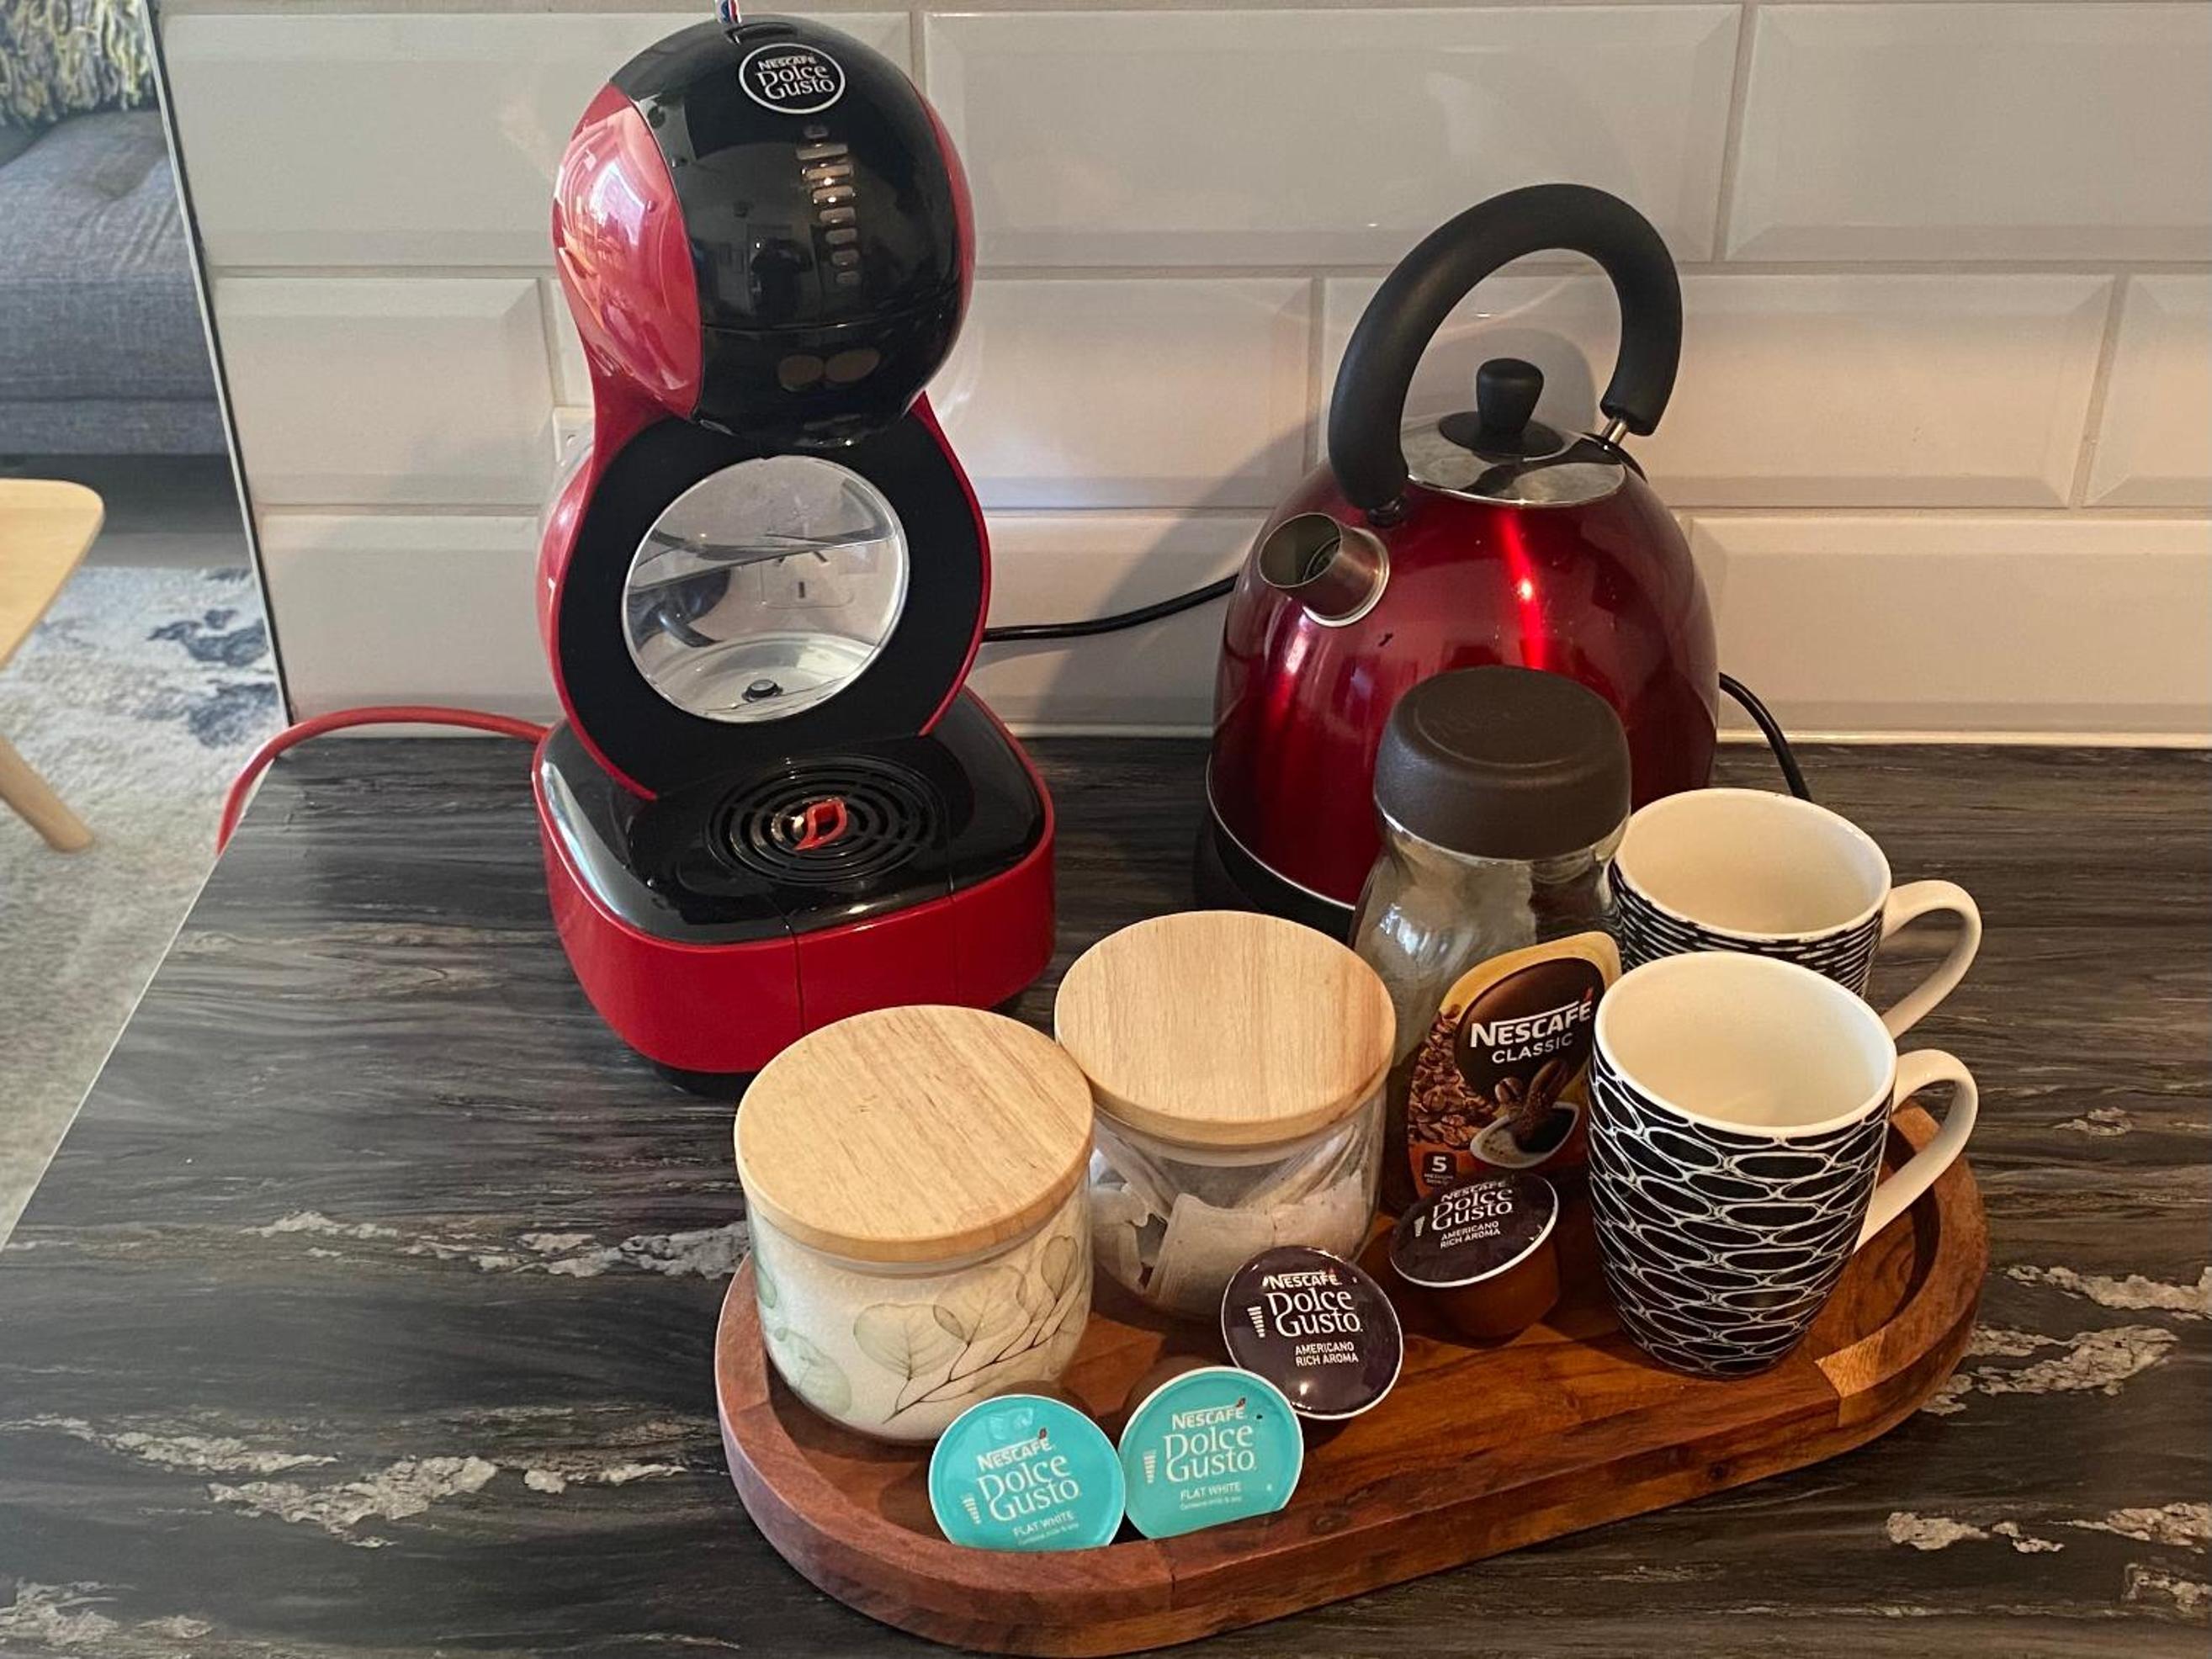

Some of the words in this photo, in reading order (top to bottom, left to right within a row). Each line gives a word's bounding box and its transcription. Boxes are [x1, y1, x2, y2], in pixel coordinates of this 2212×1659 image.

[756, 65, 830, 87] Dolce
[765, 77, 835, 99] Gusto
[1492, 1033, 1573, 1064] CLASSIC
[1432, 1156, 1447, 1172] 5
[1431, 1201, 1513, 1231] Gusto
[1433, 1188, 1513, 1218] Dolce
[1440, 1236, 1463, 1249] RICH
[1465, 1227, 1501, 1243] AROMA
[1441, 1221, 1499, 1241] AMERICANO
[1265, 1287, 1355, 1316] Dolce
[1275, 1309, 1361, 1337] Gusto
[1295, 1341, 1355, 1355] AMERICANO
[1296, 1354, 1321, 1367] RICH
[1323, 1352, 1359, 1365] AROMA
[1163, 1425, 1253, 1460] Dolce
[977, 1455, 1070, 1501] Dolce
[1166, 1448, 1255, 1482] Gusto
[989, 1479, 1079, 1521] Gusto
[1180, 1487, 1207, 1500] FLAT
[1208, 1481, 1242, 1495] WHITE
[1012, 1521, 1040, 1537] FLAT
[1040, 1510, 1074, 1528] WHITE
